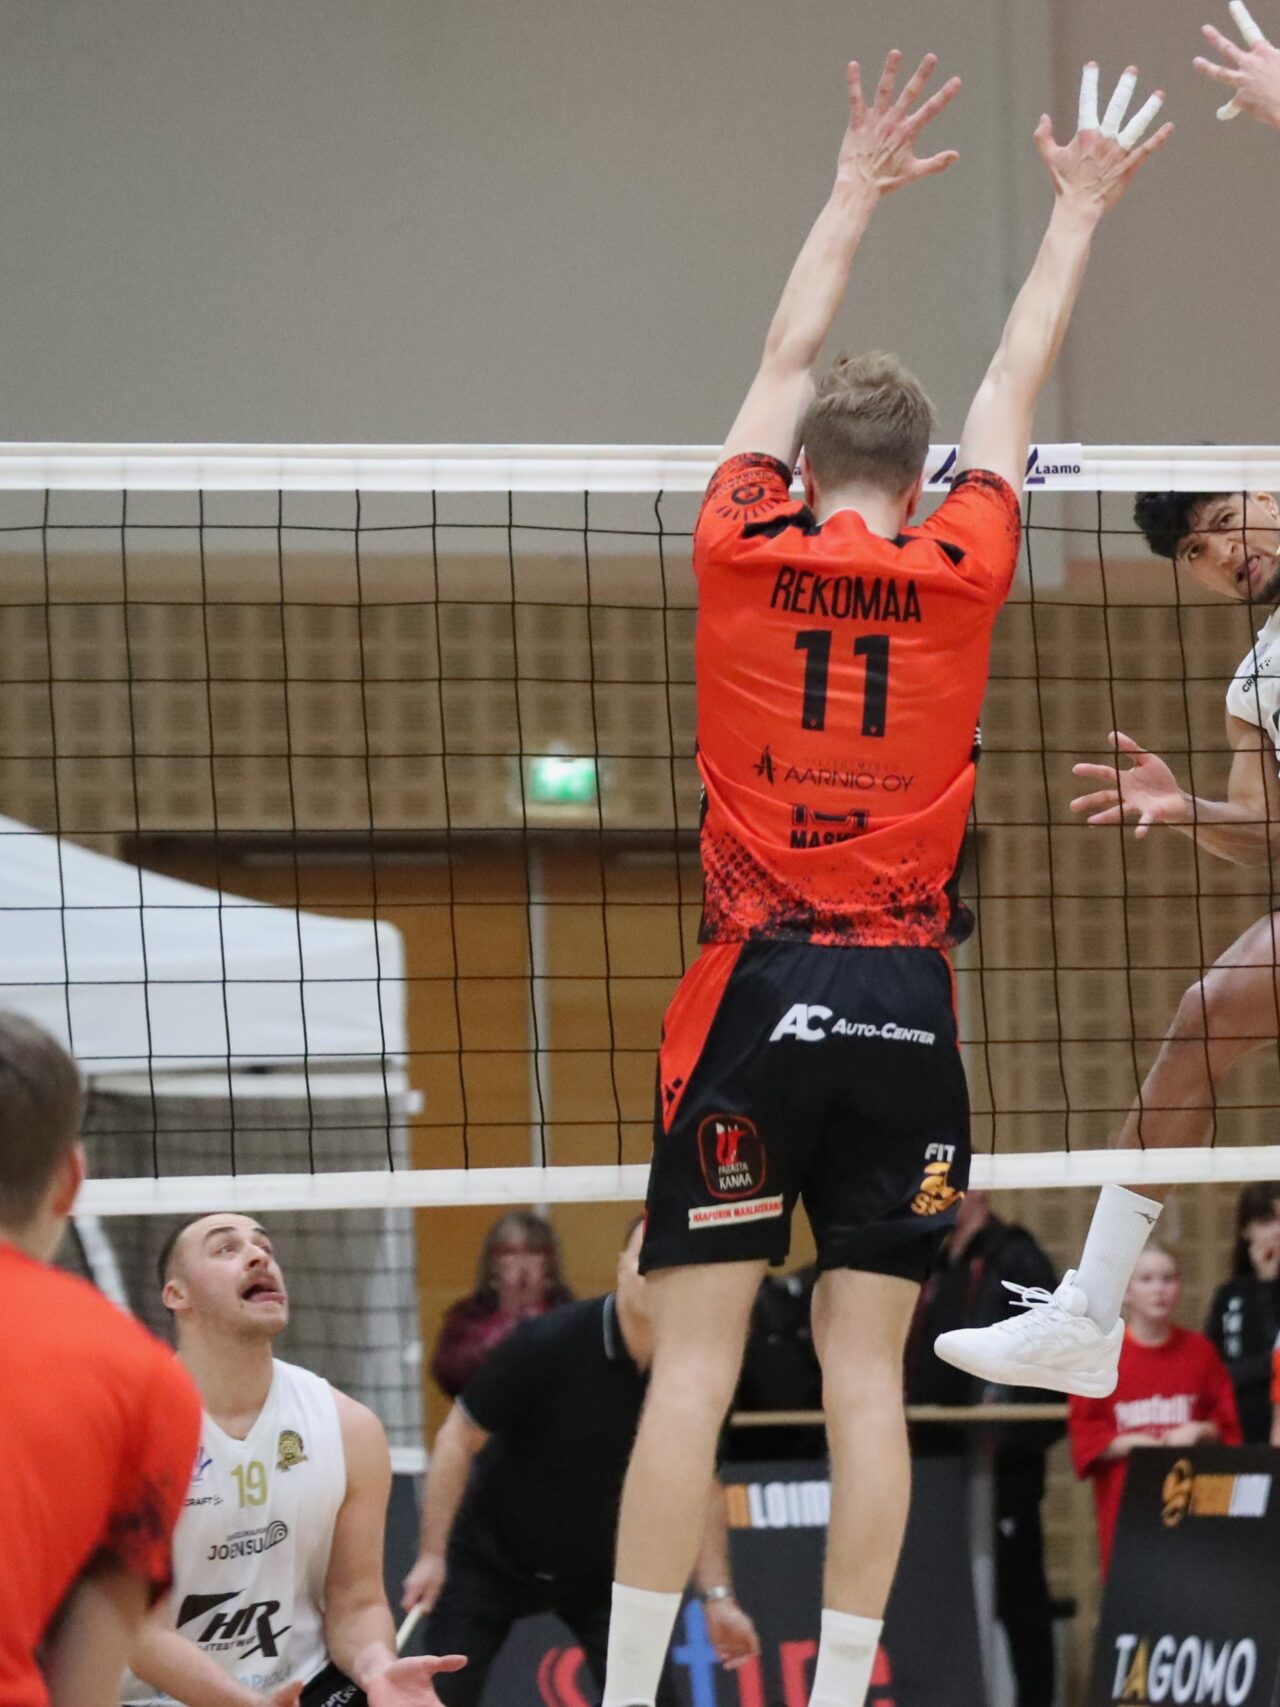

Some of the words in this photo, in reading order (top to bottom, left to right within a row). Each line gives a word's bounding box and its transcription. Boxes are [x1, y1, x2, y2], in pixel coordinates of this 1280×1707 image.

[1035, 465, 1081, 475] Laamo
[769, 564, 922, 623] REKOMAA
[794, 629, 890, 738] 11
[784, 766, 876, 790] AARNIO
[882, 774, 915, 792] OY
[768, 1003, 834, 1043] AC
[924, 1142, 956, 1163] FIT
[718, 1172, 753, 1191] KANAA
[229, 1460, 269, 1509] 19
[1111, 1633, 1258, 1706] TAGOMO
